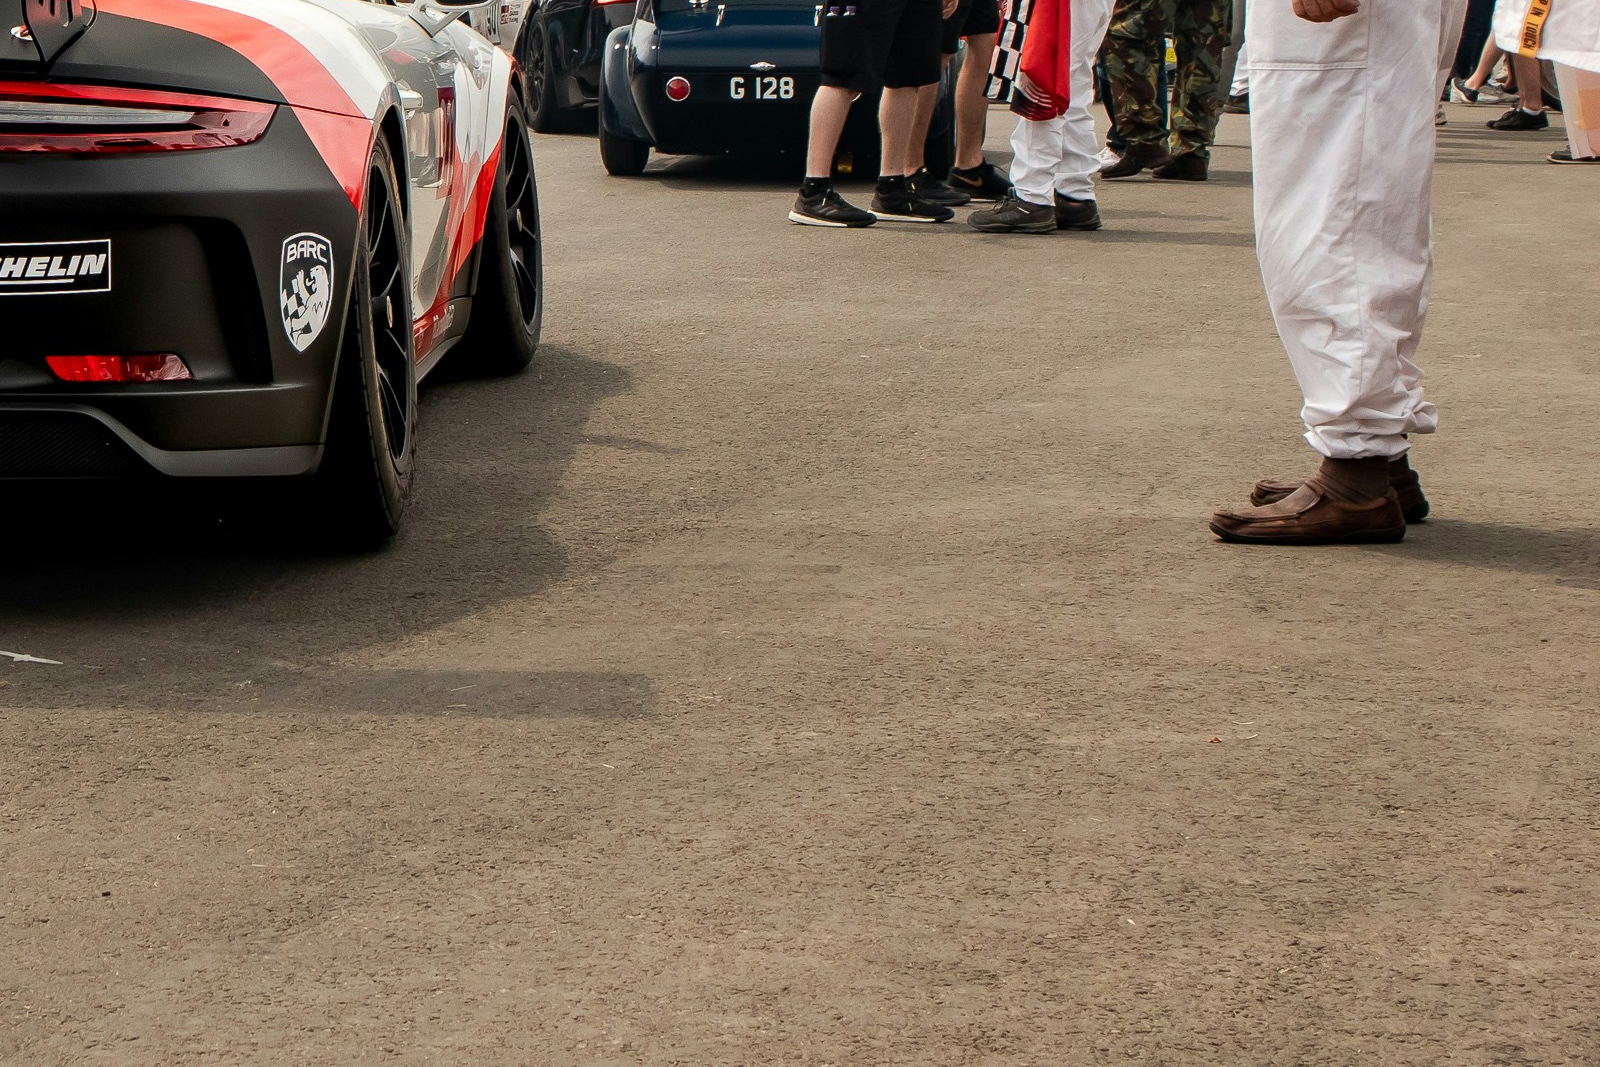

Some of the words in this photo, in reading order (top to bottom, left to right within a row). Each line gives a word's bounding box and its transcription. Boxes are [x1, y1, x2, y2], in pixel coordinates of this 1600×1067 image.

[1531, 7, 1544, 18] IN
[1523, 22, 1538, 50] TOUCH
[730, 76, 745, 99] G
[755, 76, 795, 99] 128
[286, 240, 328, 263] BARC
